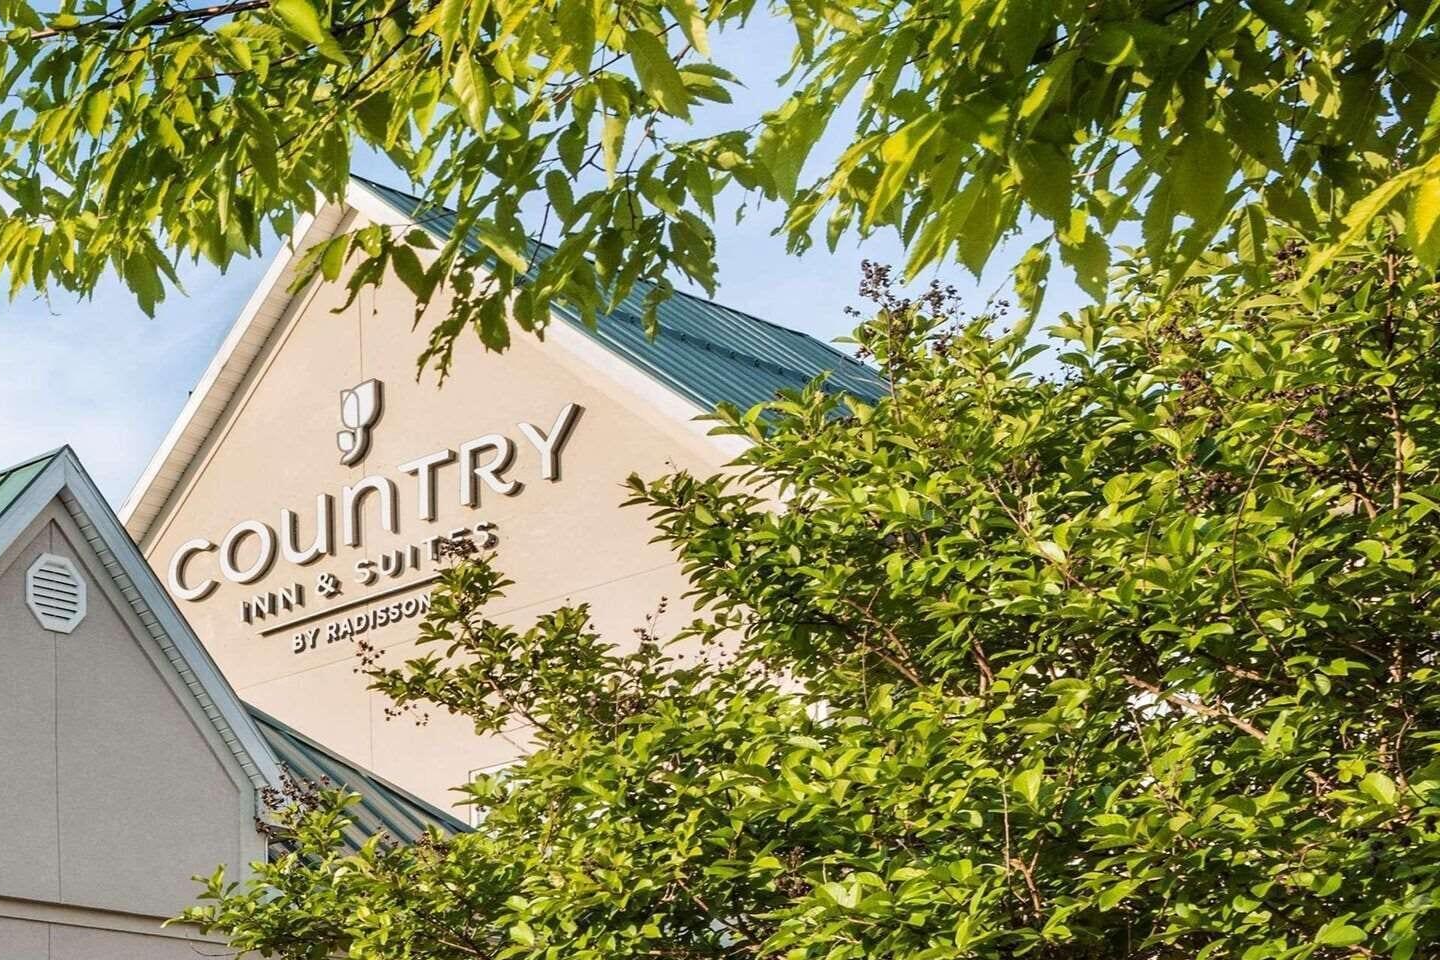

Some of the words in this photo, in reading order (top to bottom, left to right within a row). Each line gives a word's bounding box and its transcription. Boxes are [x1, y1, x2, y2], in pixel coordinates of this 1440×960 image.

[240, 583, 305, 625] INN
[316, 572, 341, 597] &
[293, 628, 320, 653] BY
[326, 593, 432, 643] RADISSON
